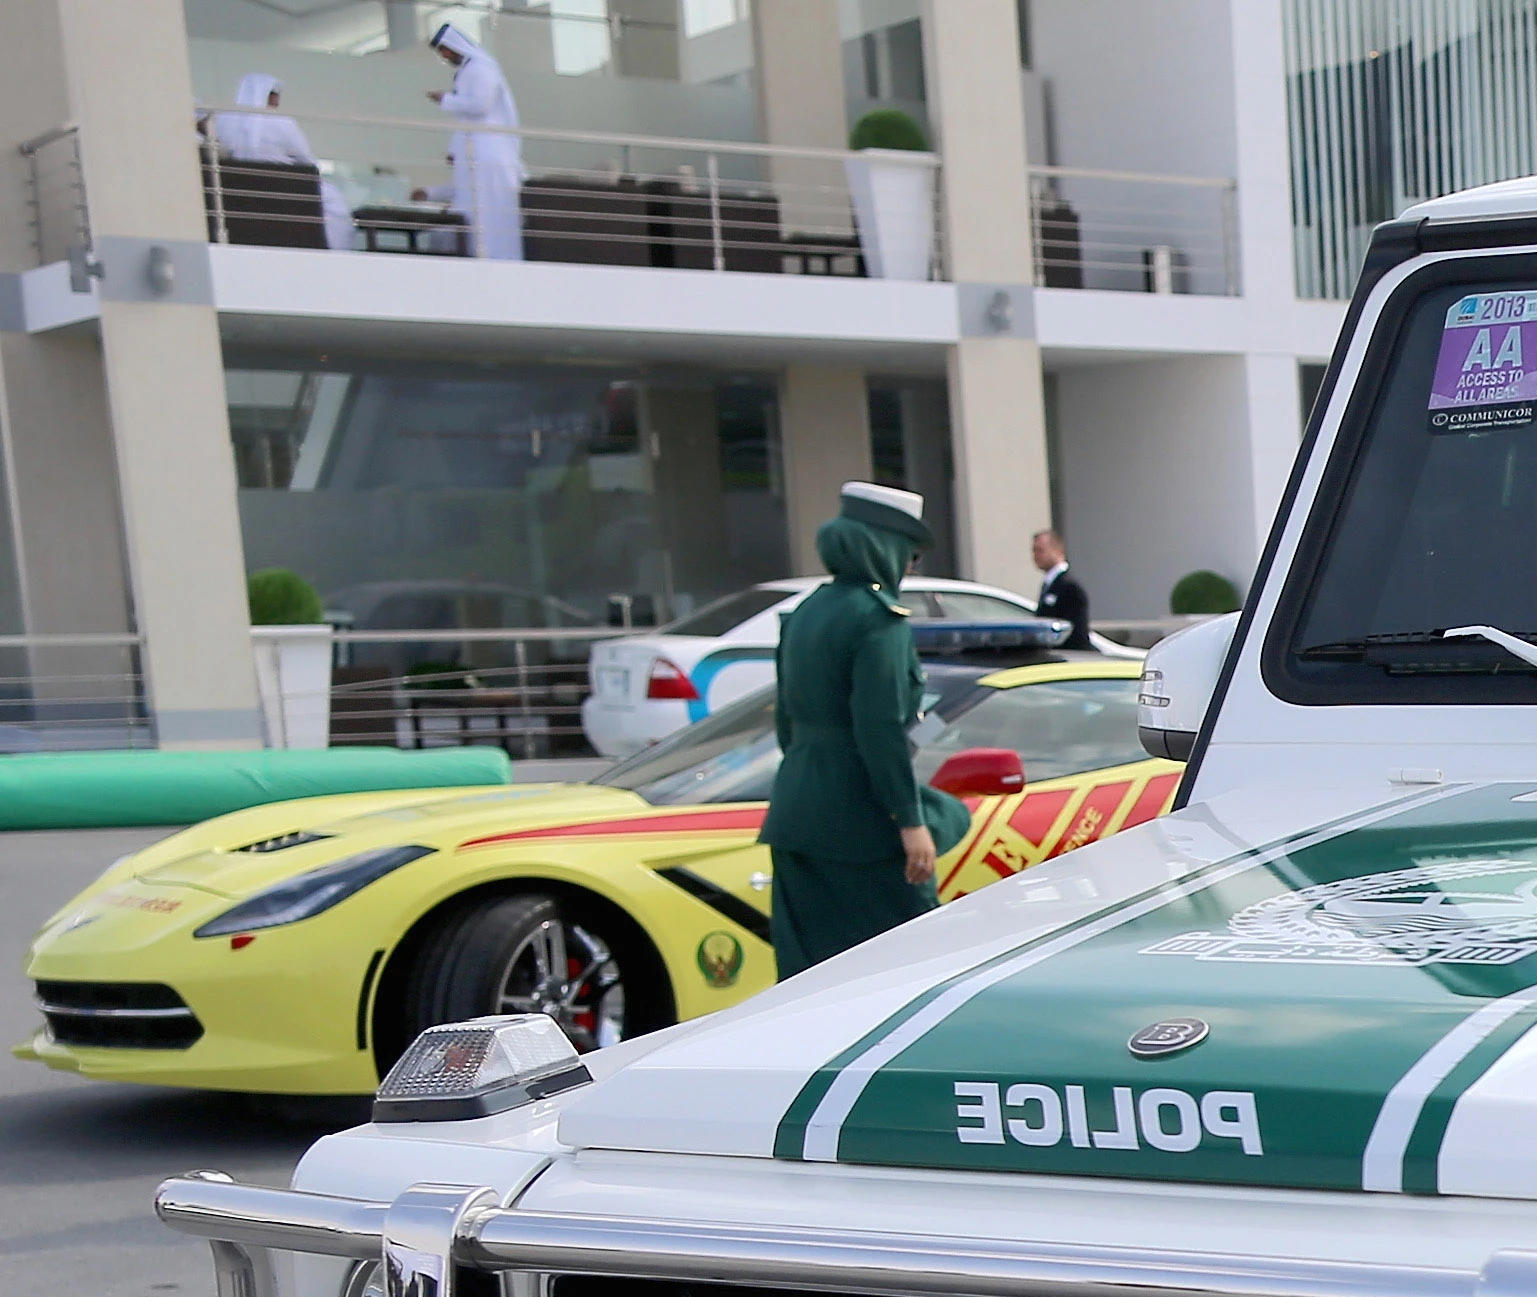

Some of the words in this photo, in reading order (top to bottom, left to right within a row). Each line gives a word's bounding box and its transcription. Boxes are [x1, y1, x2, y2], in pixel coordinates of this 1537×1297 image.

[1480, 296, 1526, 320] 2013
[1462, 325, 1523, 372] AA
[1456, 371, 1507, 388] ACCESS
[1508, 369, 1524, 382] TO
[1454, 389, 1477, 404] ALL
[1477, 386, 1520, 401] AREAS
[1450, 408, 1532, 423] COMMUNICOR
